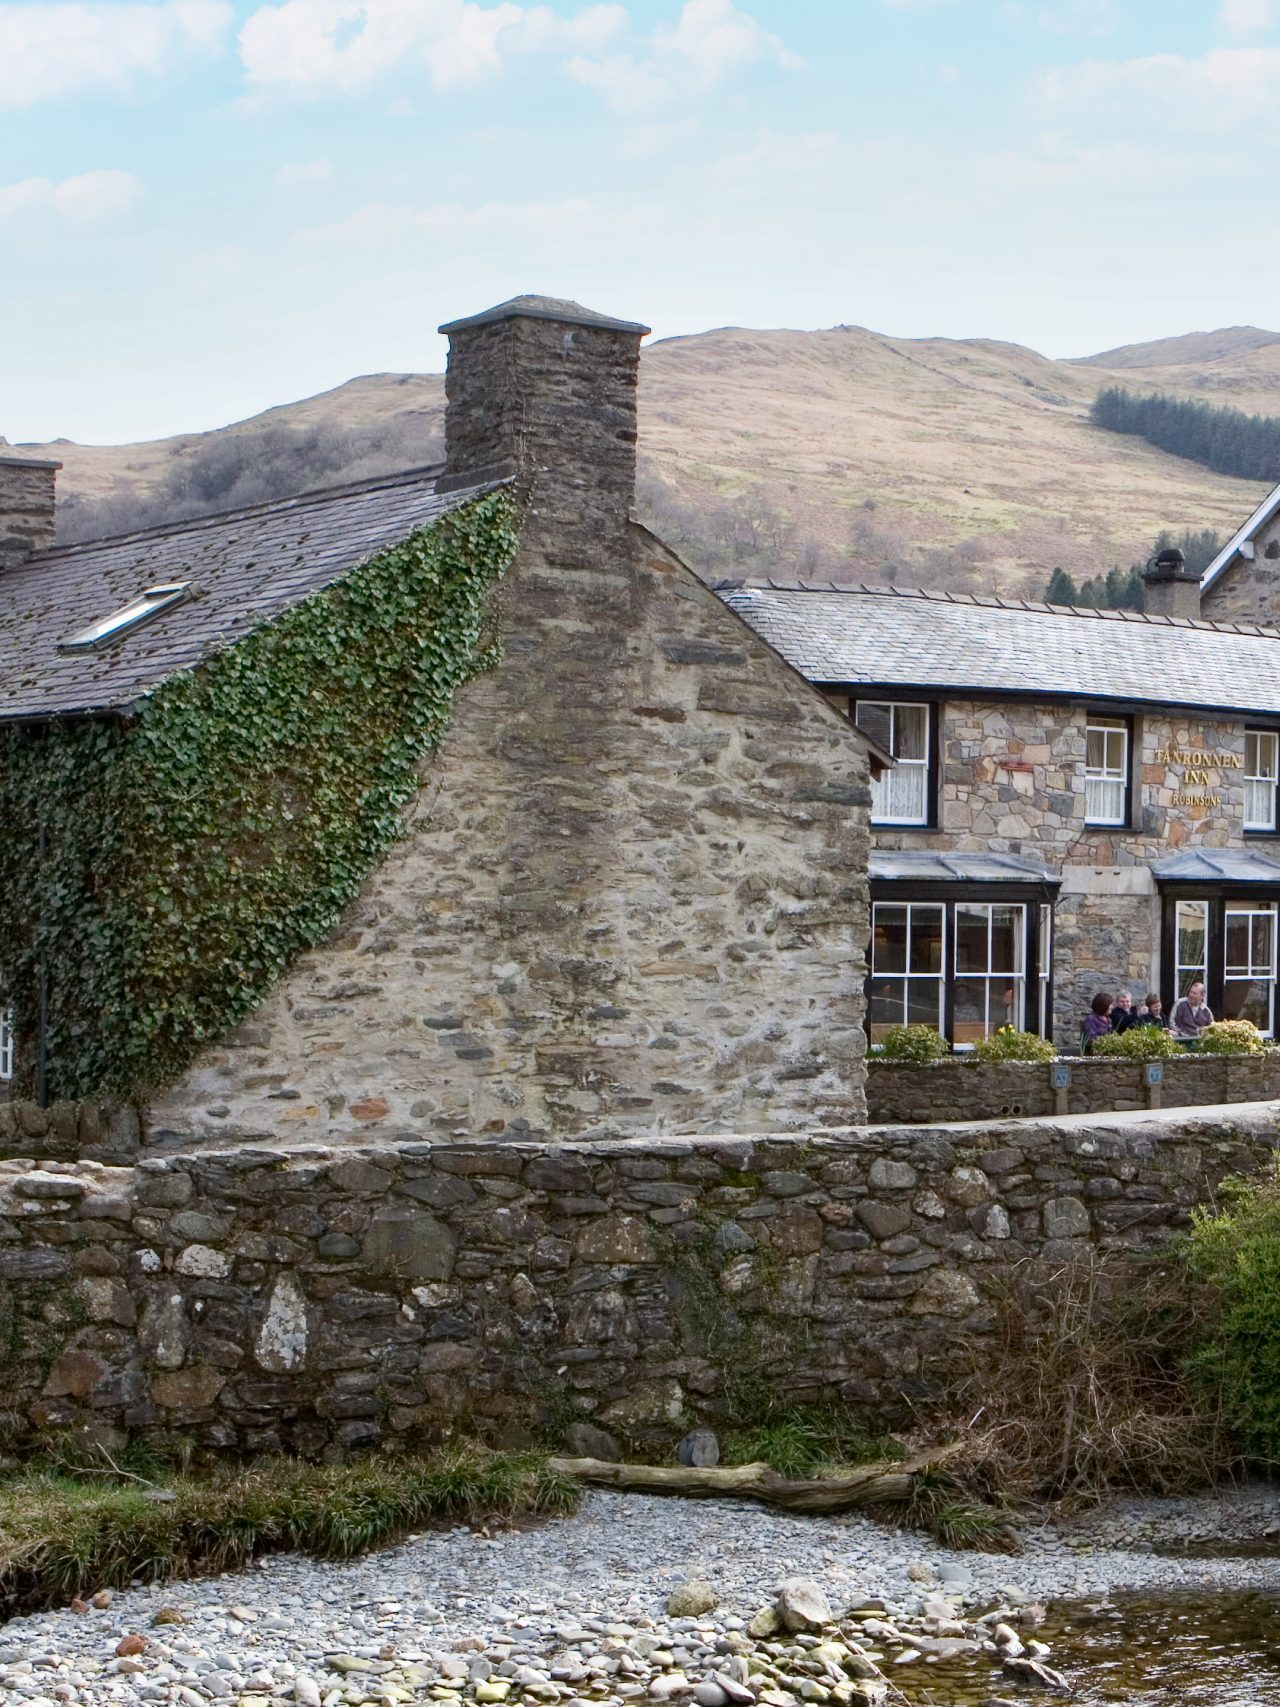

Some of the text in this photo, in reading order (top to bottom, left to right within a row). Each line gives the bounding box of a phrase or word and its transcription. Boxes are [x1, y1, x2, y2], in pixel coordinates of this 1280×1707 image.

[1155, 749, 1241, 768] TANRONNEN
[1184, 769, 1209, 785] INN
[1173, 794, 1222, 806] ROBINSONS
